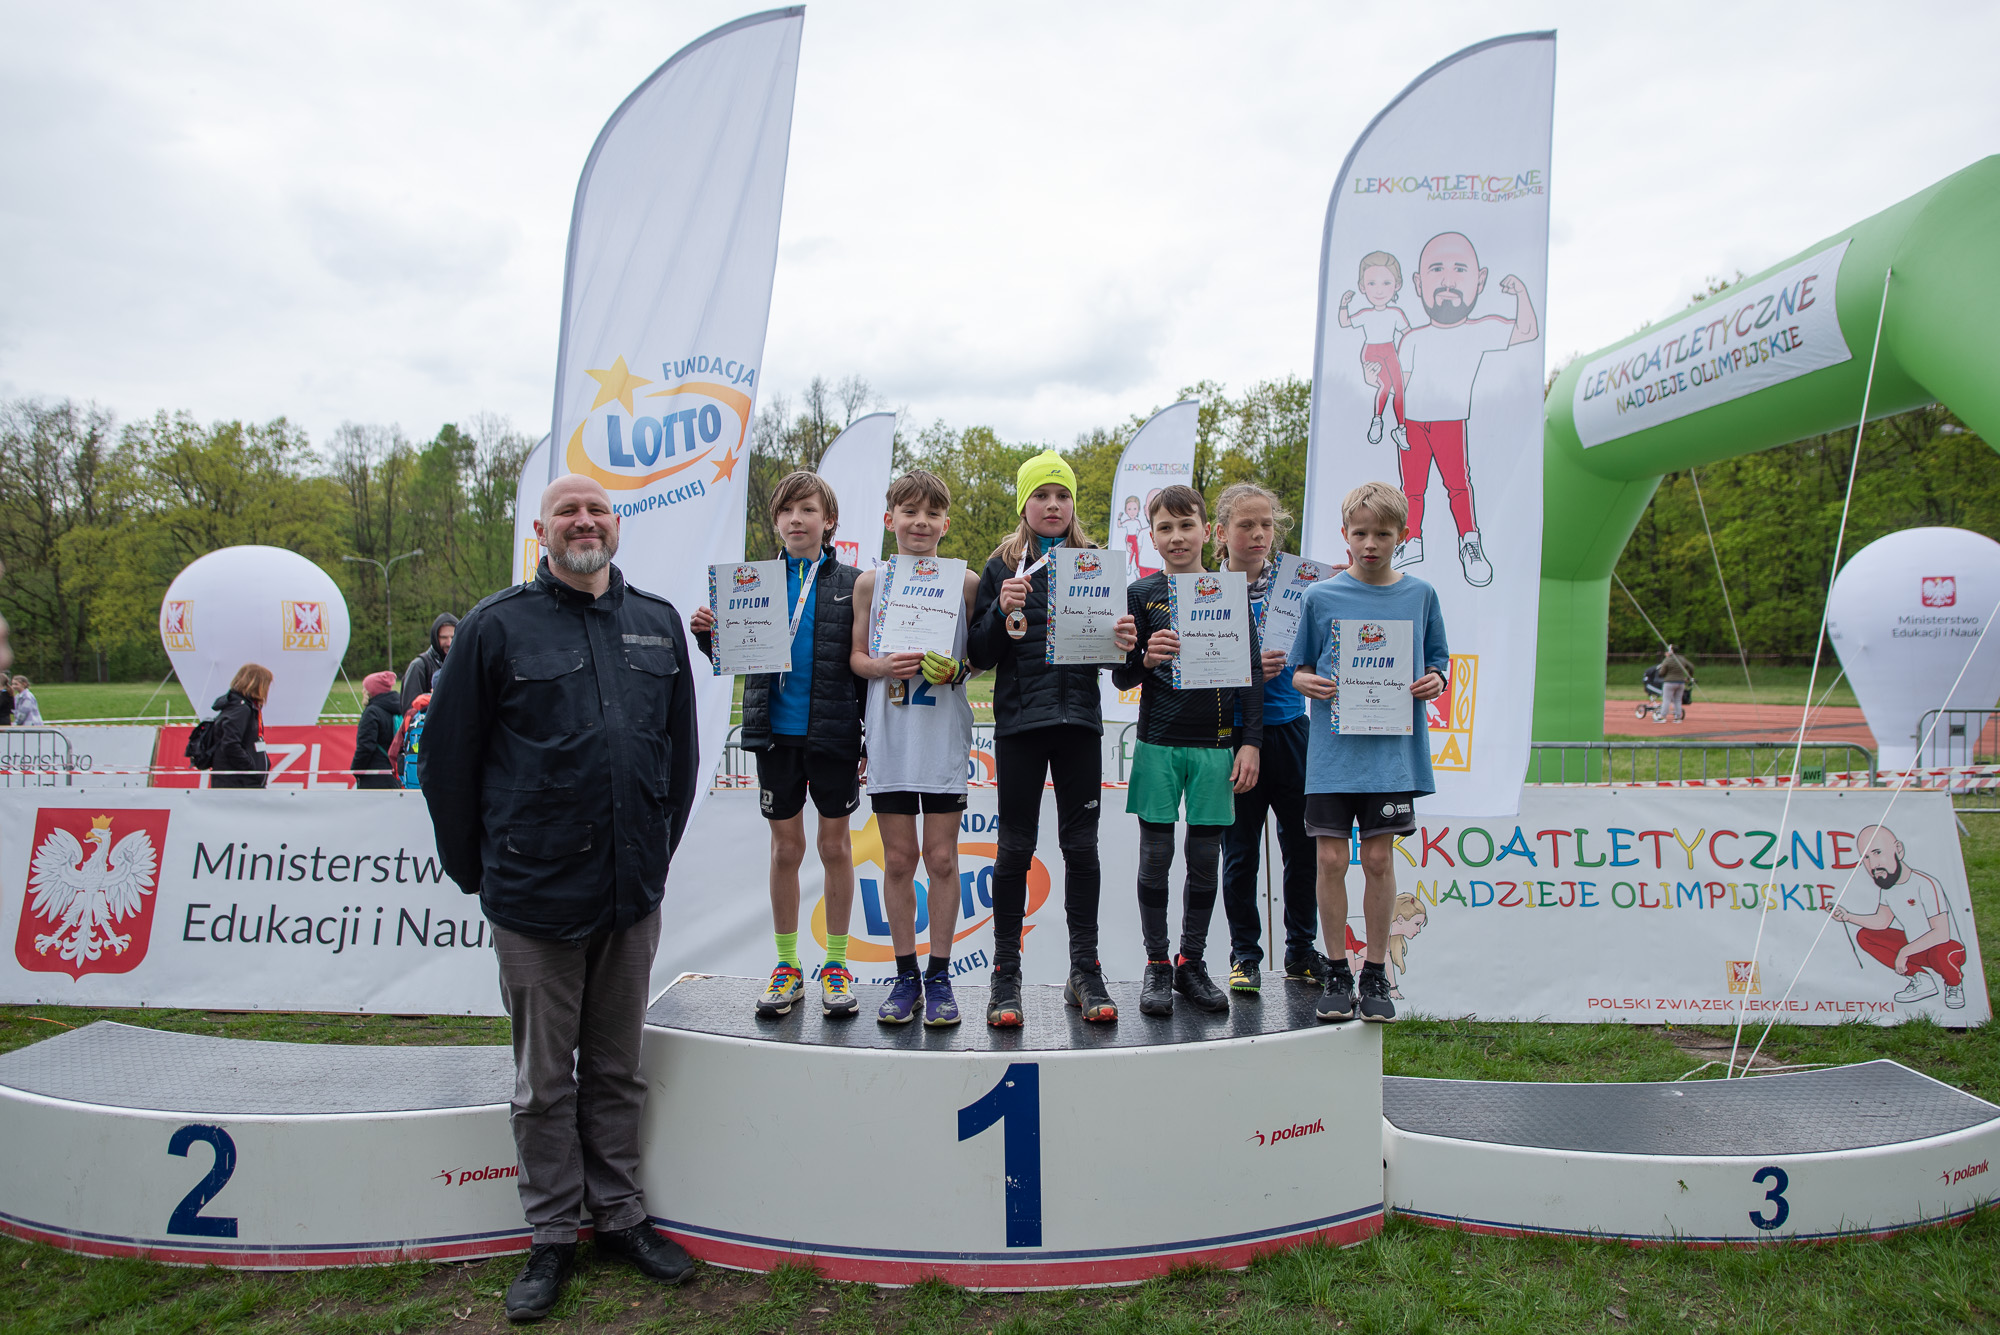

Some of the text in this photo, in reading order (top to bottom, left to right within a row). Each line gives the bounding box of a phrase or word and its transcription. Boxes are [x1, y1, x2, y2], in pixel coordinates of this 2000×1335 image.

[1354, 170, 1541, 194] LEKKOATLETYCZNE
[1427, 186, 1544, 202] NADZIEJE OLIMPIJSKIE
[1583, 274, 1818, 401] LEKKOATLETYCZNE
[662, 355, 755, 387] FUNDACJA
[1616, 326, 1803, 415] NADZIEJE OLIMPIJSKIE
[607, 404, 722, 467] LOTTO
[613, 479, 706, 518] KONOPACKIEJ
[902, 586, 944, 598] DYPLOM
[1069, 585, 1110, 597] DYPLOM
[1283, 589, 1302, 601] DYP
[729, 597, 770, 610] DYPLOM
[1191, 609, 1231, 621] DYPLOM
[1898, 615, 1979, 625] Ministerstwo
[165, 634, 192, 648] ZLA
[286, 635, 326, 648] PZLA
[1892, 628, 1941, 639] Edukacji
[1352, 657, 1395, 668] DYPLOM
[1121, 691, 1141, 701] PZ
[1803, 771, 1822, 781] AWF
[1349, 826, 1859, 870] KKOATLETYCZNE
[192, 842, 444, 884] Ministerstw
[1416, 880, 1835, 911] NADZIEJE OLIMPIJSKIE
[183, 903, 494, 955] Edukacji i Nau
[1588, 998, 1895, 1013] POLSKI ZWIĄZEK LEKKIEJ ATLETYKI
[1270, 1118, 1325, 1146] polanik
[958, 1062, 1042, 1247] 1
[167, 1123, 238, 1237] 2
[1953, 1158, 1989, 1185] polanik
[1748, 1166, 1789, 1230] 3
